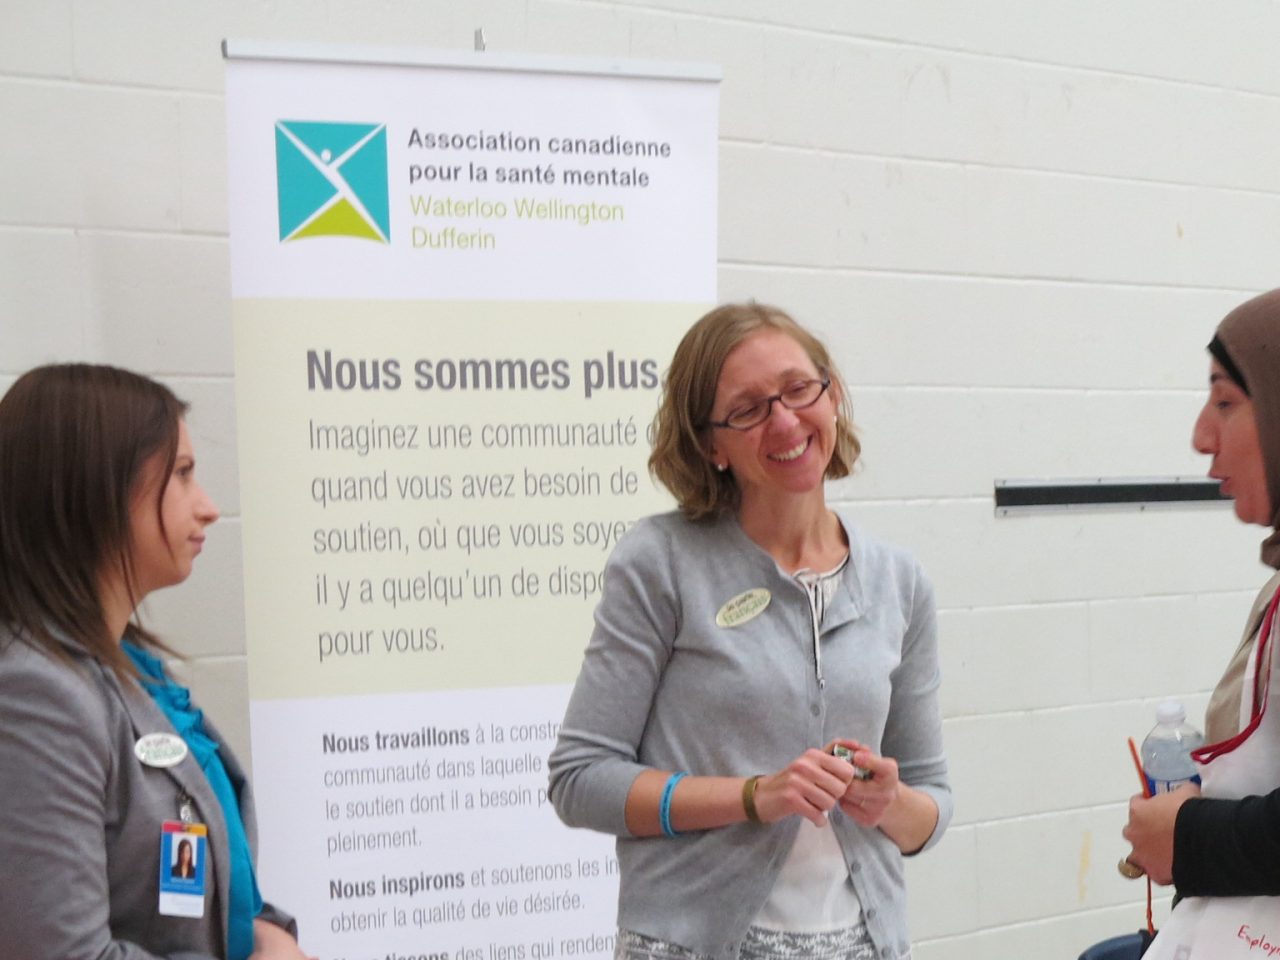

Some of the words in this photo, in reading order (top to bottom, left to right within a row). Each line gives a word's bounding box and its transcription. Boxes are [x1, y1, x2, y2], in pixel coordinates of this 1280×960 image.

[408, 128, 541, 154] Association
[548, 134, 671, 158] canadienne
[409, 164, 462, 184] pour
[469, 161, 488, 183] la
[495, 164, 556, 185] santé
[563, 165, 650, 187] mentale
[410, 194, 507, 219] Waterloo
[514, 197, 624, 225] Wellington
[412, 225, 496, 250] Dufferin
[307, 350, 401, 391] Nous
[415, 358, 570, 391] sommes
[309, 419, 419, 456] Imaginez
[428, 424, 472, 449] une
[481, 416, 637, 448] communauté
[311, 470, 388, 508] quand
[397, 475, 452, 500] vous
[461, 473, 515, 498] avez
[524, 466, 600, 497] besoin
[610, 464, 639, 495] de
[313, 521, 410, 555] soutien,
[418, 517, 447, 550] où
[457, 522, 501, 555] que
[509, 521, 564, 547] vous
[573, 520, 636, 551] soye
[316, 572, 328, 605] il
[336, 579, 351, 611] y
[360, 579, 374, 603] a
[382, 570, 502, 608] quelqu'un
[512, 567, 540, 596] de
[318, 629, 373, 663] pour
[382, 625, 445, 655] vous.
[322, 733, 369, 754] Nous
[375, 727, 470, 751] travaillons
[475, 725, 486, 744] à
[490, 723, 505, 743] la
[510, 720, 561, 742] constr
[323, 758, 431, 788] communauté
[436, 756, 475, 781] dans
[481, 752, 542, 780] laquelle
[325, 799, 340, 821] le
[346, 793, 404, 819] soutien
[410, 791, 445, 815] dont
[451, 789, 460, 811] il
[465, 791, 475, 809] a
[480, 785, 531, 808] besoin
[327, 827, 422, 857] pleinement.
[329, 877, 376, 900] Nous
[382, 870, 465, 896] inspirons
[471, 866, 486, 887] et
[491, 861, 572, 885] soutenons
[577, 857, 600, 880] les
[331, 908, 388, 934] obtenir
[393, 906, 406, 928] la
[412, 898, 466, 930] qualité
[471, 897, 491, 920] de
[496, 896, 518, 917] vie
[523, 891, 586, 915] désirée.
[560, 931, 617, 957] renden
